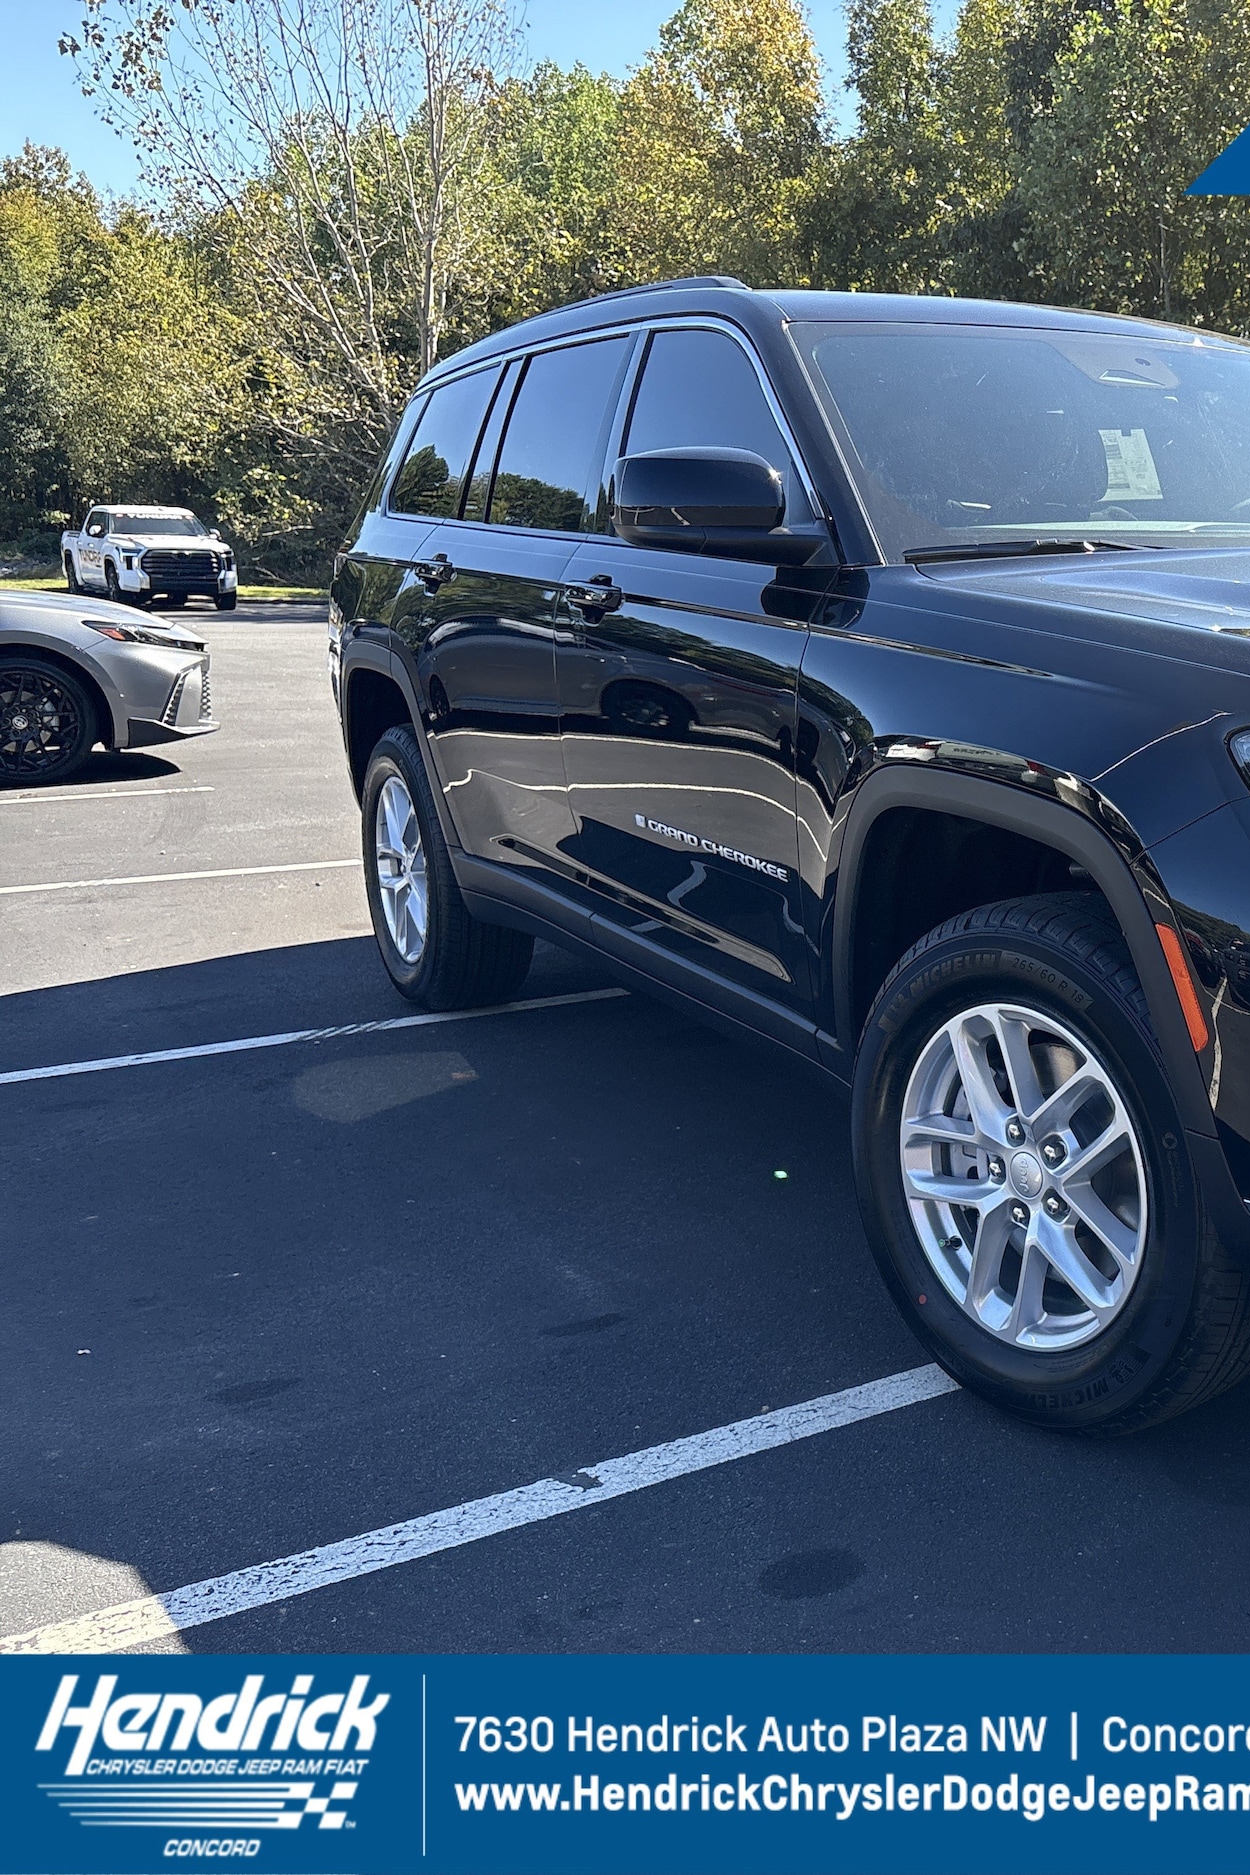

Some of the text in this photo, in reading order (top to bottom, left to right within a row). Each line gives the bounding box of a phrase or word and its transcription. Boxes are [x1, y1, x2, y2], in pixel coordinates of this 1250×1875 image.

[647, 818, 789, 883] GRAND CHEROKEE
[909, 953, 1085, 1005] MICHELIN 265/60 R 18
[1018, 1157, 1030, 1194] Jeep
